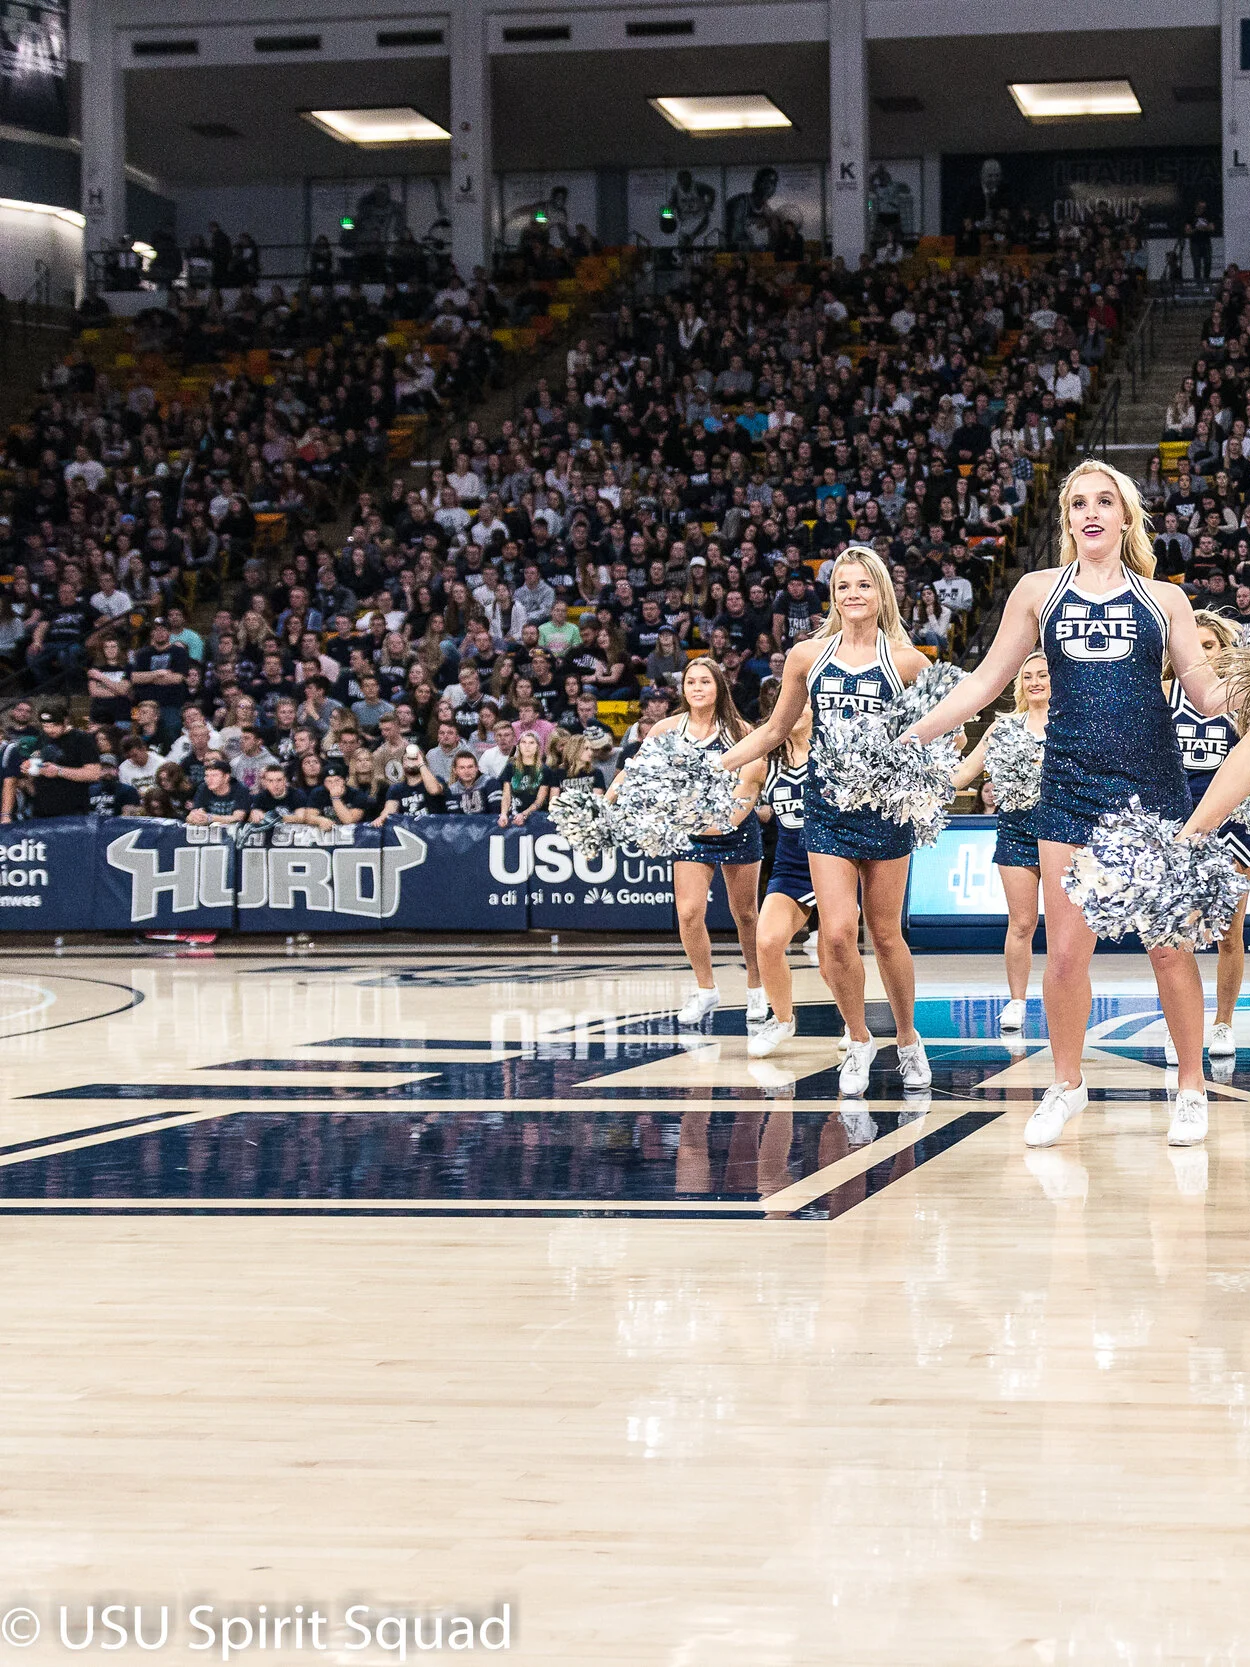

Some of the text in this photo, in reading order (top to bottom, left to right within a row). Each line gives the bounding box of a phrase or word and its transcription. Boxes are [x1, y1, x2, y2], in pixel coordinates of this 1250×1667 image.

[1233, 149, 1248, 167] L
[840, 162, 855, 179] K
[460, 174, 471, 192] J
[1055, 618, 1138, 641] STATE
[816, 693, 882, 713] STATE
[772, 798, 805, 816] STA
[488, 833, 618, 884] USU
[106, 825, 428, 923] HURD
